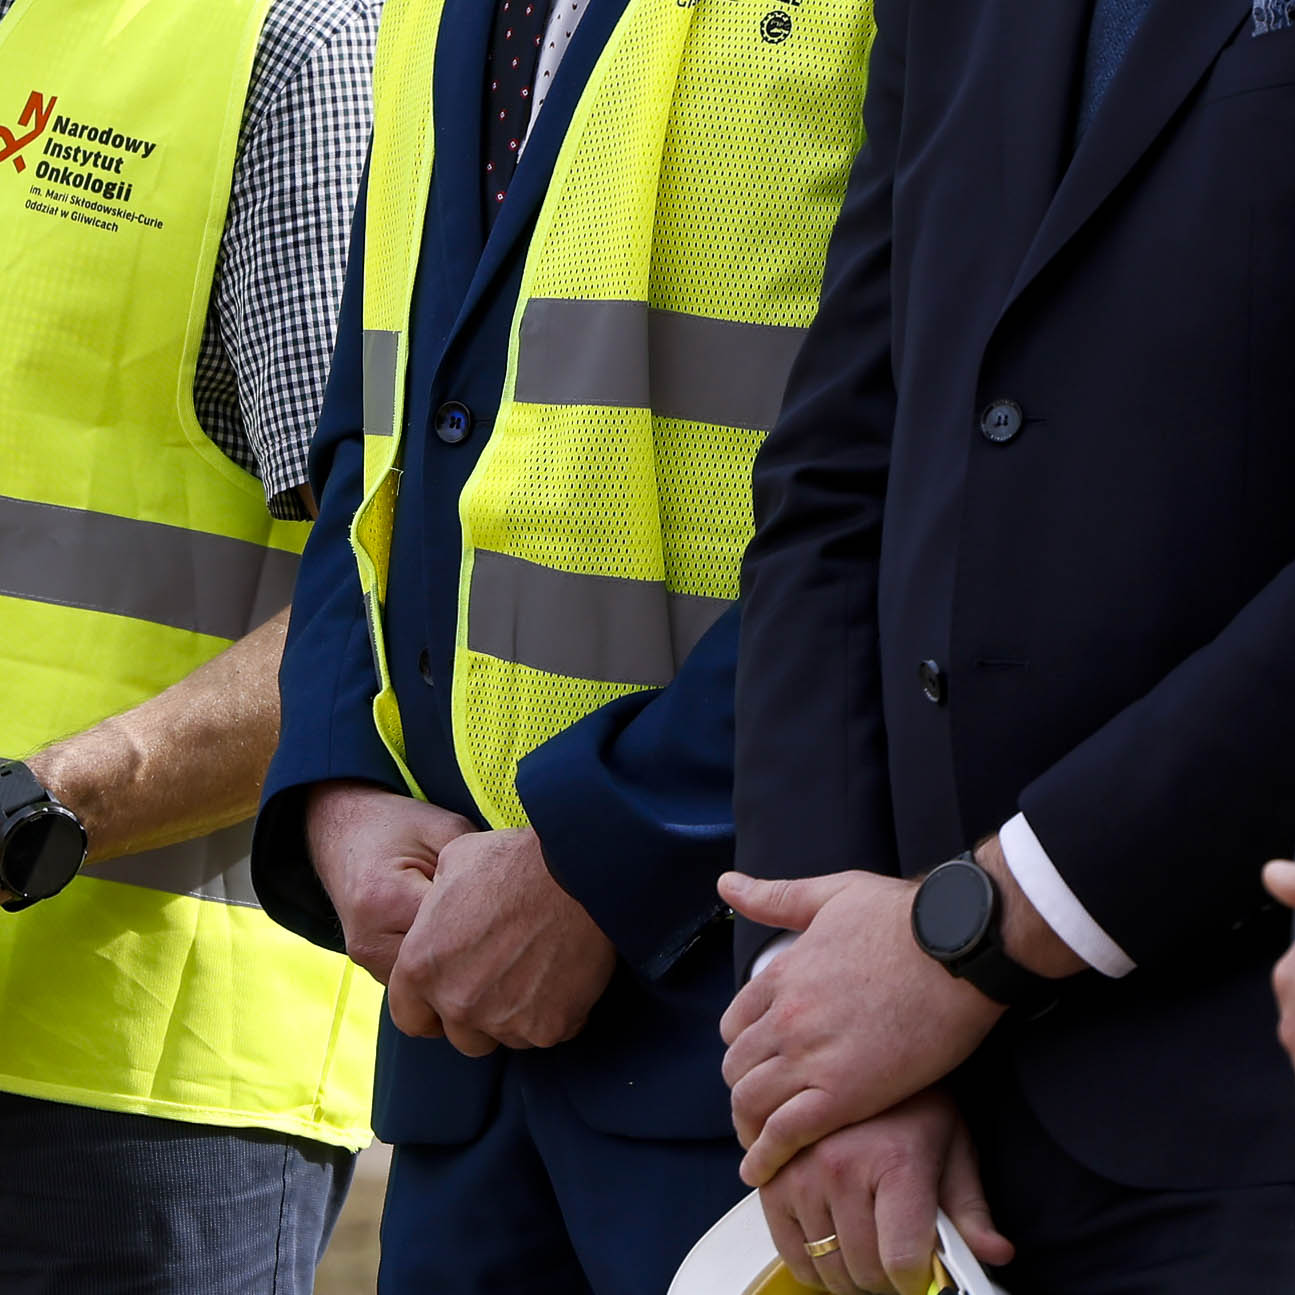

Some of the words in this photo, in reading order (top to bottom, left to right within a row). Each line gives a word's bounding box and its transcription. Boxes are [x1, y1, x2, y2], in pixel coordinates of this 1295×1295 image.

[43, 137, 124, 174] Instytut
[51, 115, 156, 159] Narodowy
[35, 160, 133, 202] Onkologii
[25, 199, 59, 216] Oddział
[60, 208, 69, 218] w
[70, 210, 119, 233] Gliwicach
[29, 185, 43, 197] im.
[45, 188, 69, 203] Marii
[69, 194, 164, 230] Skłodowskiej-Curie
